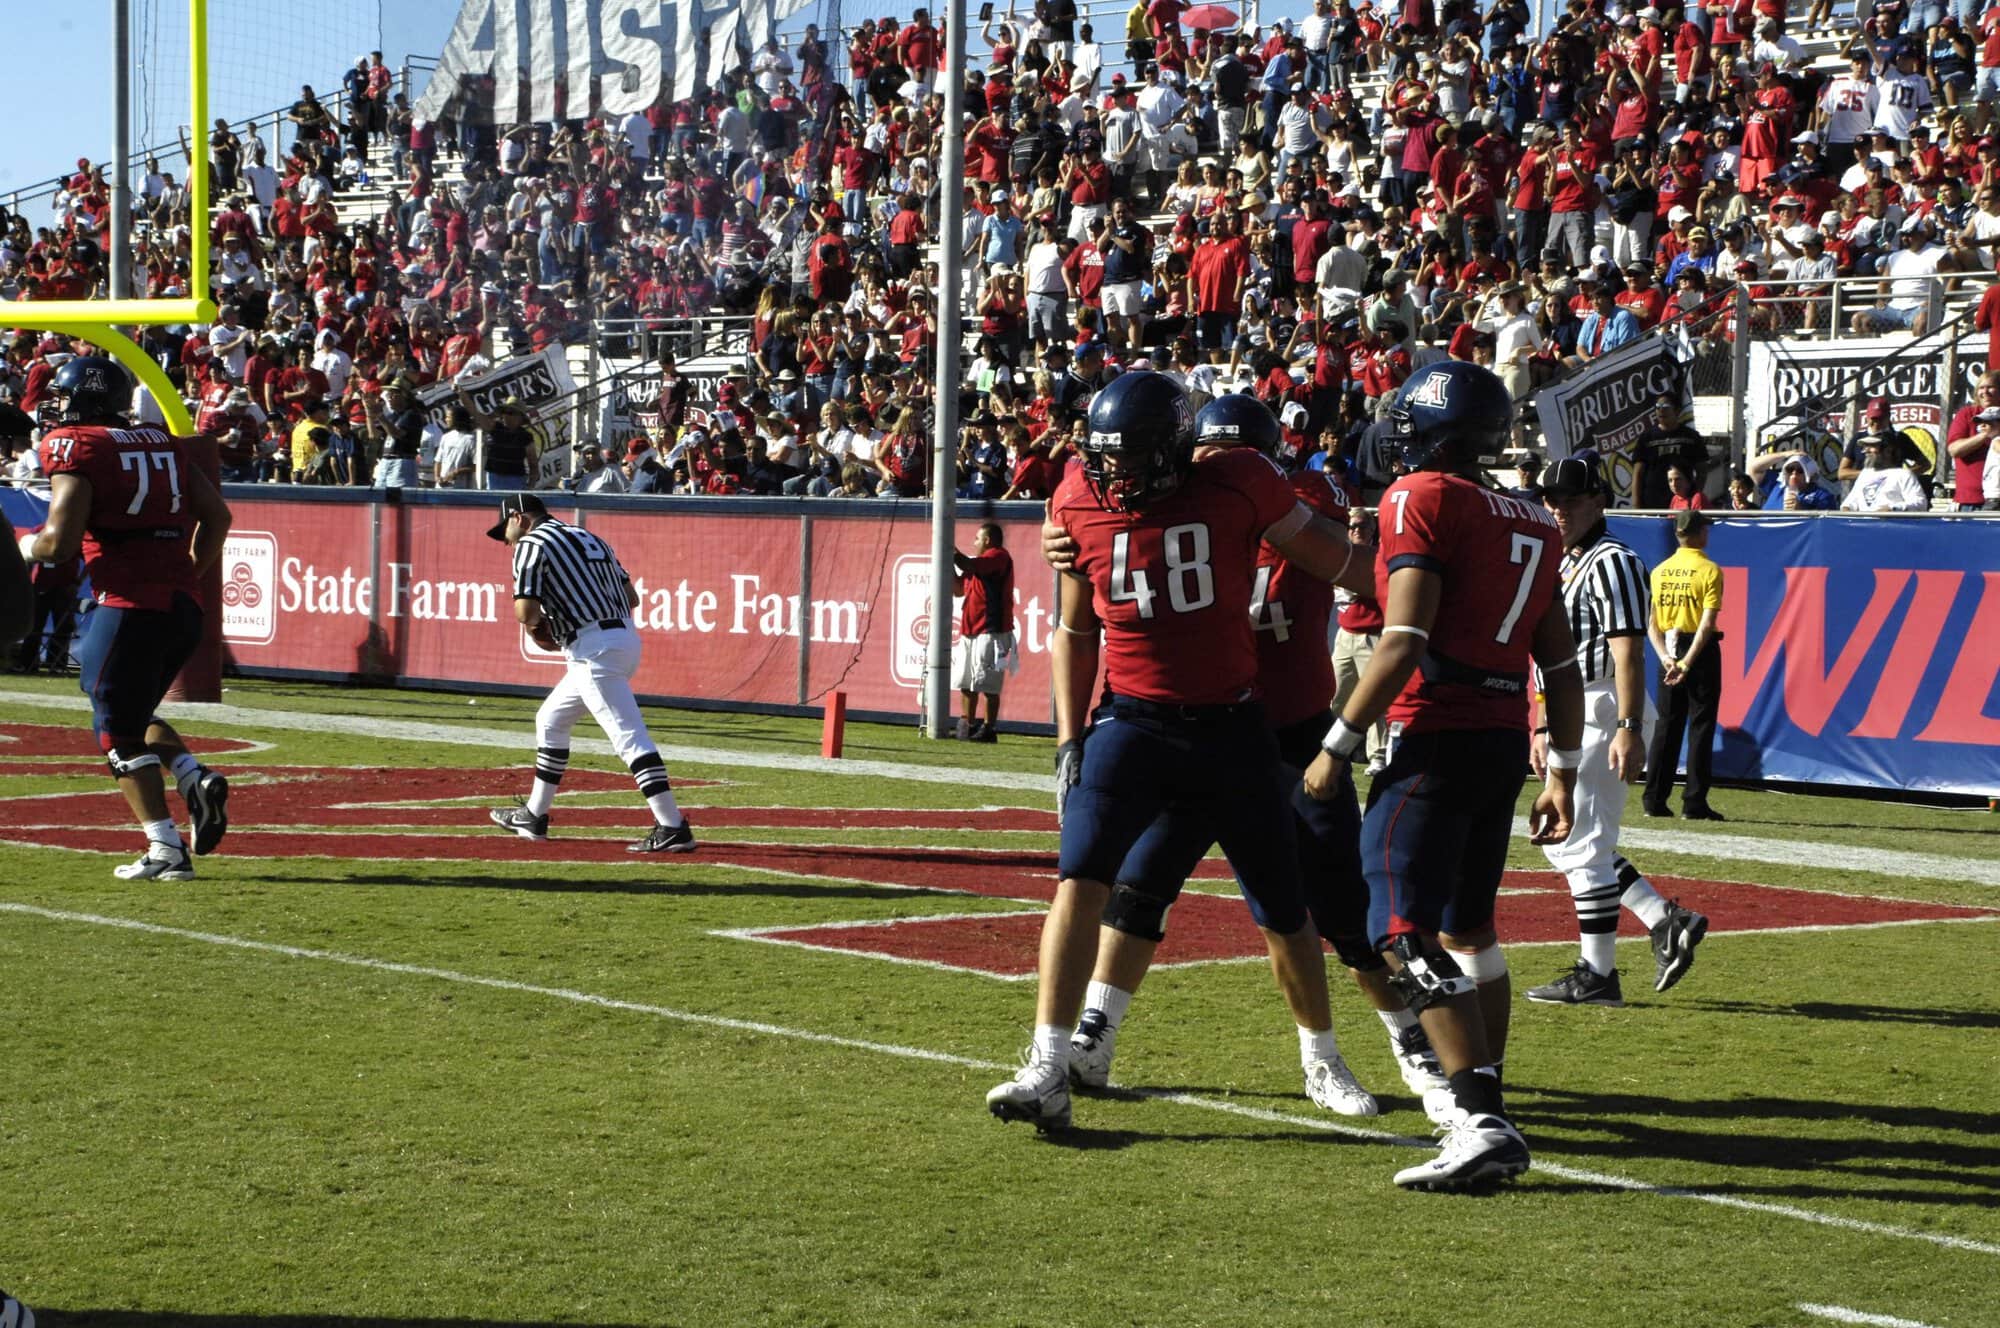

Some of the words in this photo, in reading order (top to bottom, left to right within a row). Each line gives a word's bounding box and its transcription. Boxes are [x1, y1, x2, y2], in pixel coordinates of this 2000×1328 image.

[1890, 408, 1932, 423] RESH
[1600, 420, 1646, 452] BAKED
[119, 451, 183, 515] 77
[1390, 489, 1412, 536] 7
[222, 546, 240, 557] TATE
[244, 547, 267, 557] FARM
[906, 574, 932, 585] STAT
[1110, 522, 1215, 620] 48
[1661, 568, 1697, 577] EVENT
[1661, 582, 1692, 590] STAFF
[280, 556, 372, 617] State
[387, 561, 498, 623] Farm
[1495, 531, 1544, 645] 7
[222, 614, 266, 627] SURANCE
[631, 577, 716, 634] tate
[730, 574, 861, 645] Farm
